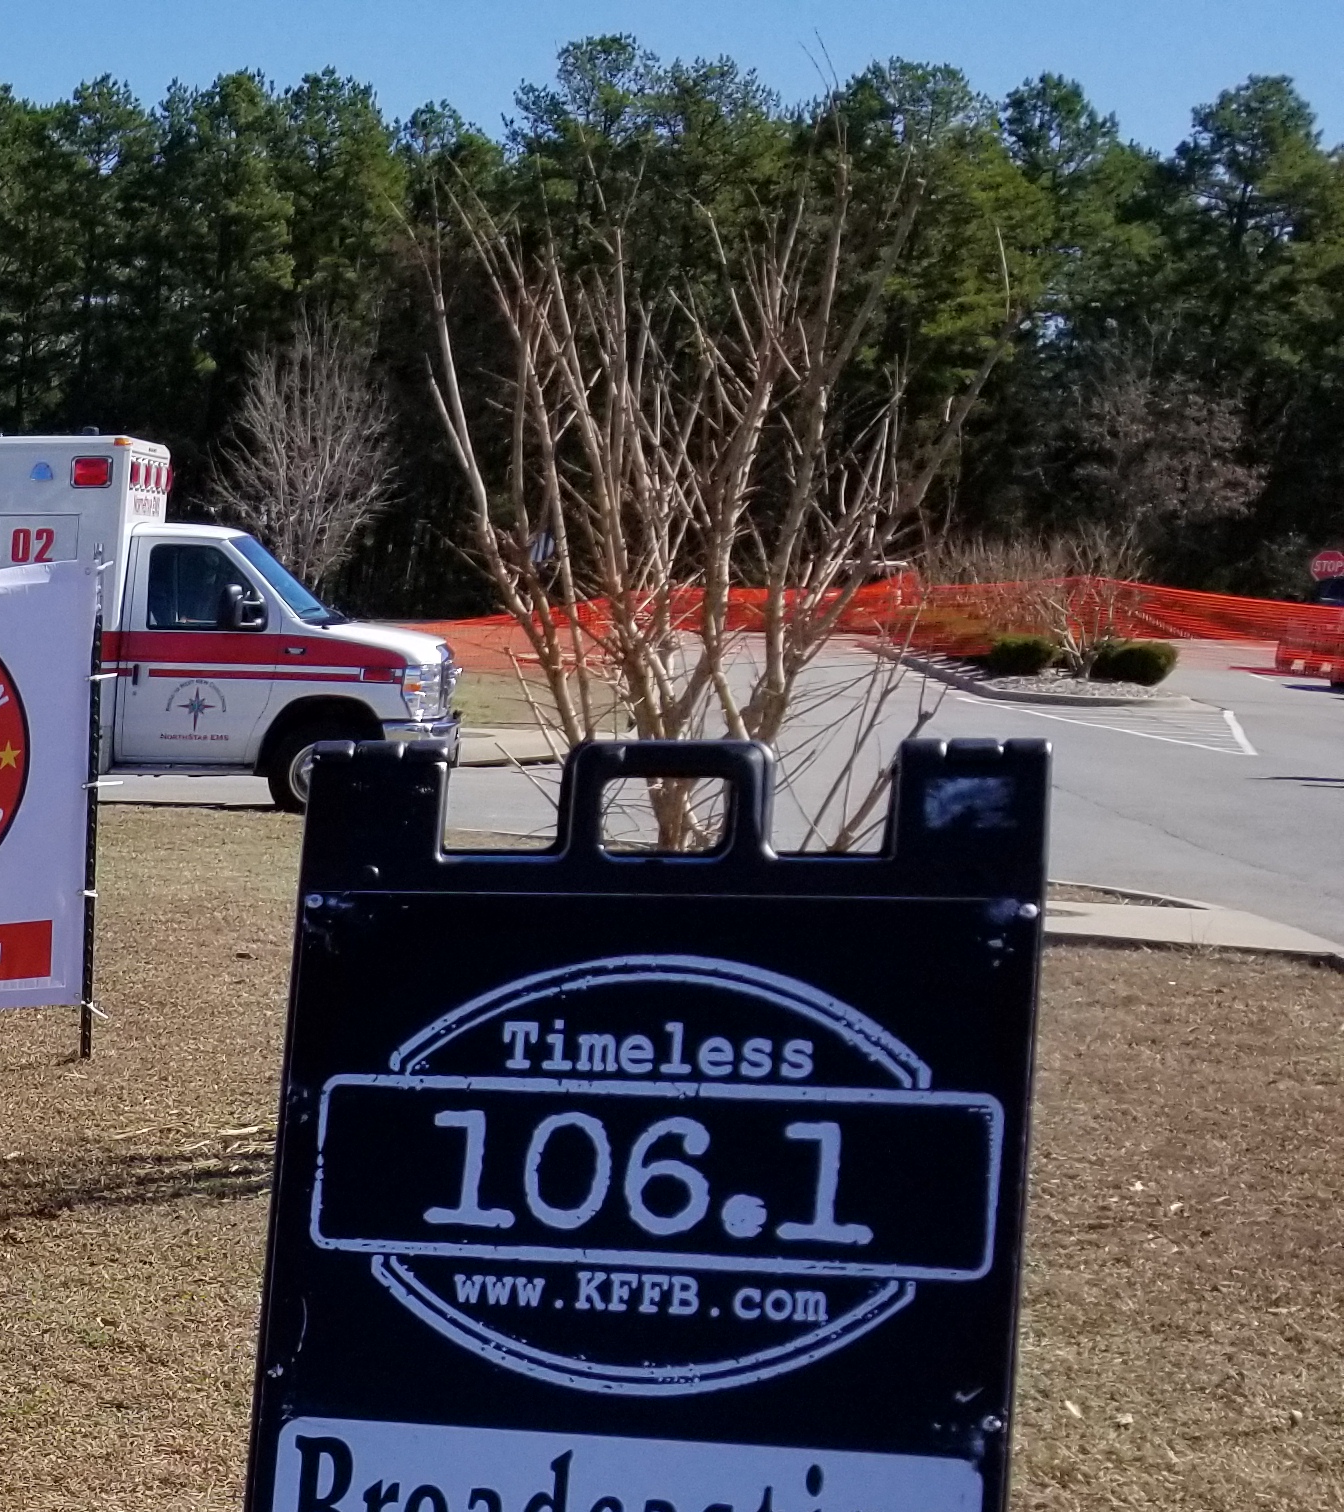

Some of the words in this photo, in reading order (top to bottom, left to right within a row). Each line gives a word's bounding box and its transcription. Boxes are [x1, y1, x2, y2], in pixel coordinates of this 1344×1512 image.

[11, 528, 55, 563] 02
[1314, 560, 1343, 572] STOP
[502, 1019, 814, 1081] Timeless
[422, 1108, 874, 1246] 106.1
[453, 1270, 829, 1325] www.KFFB.com
